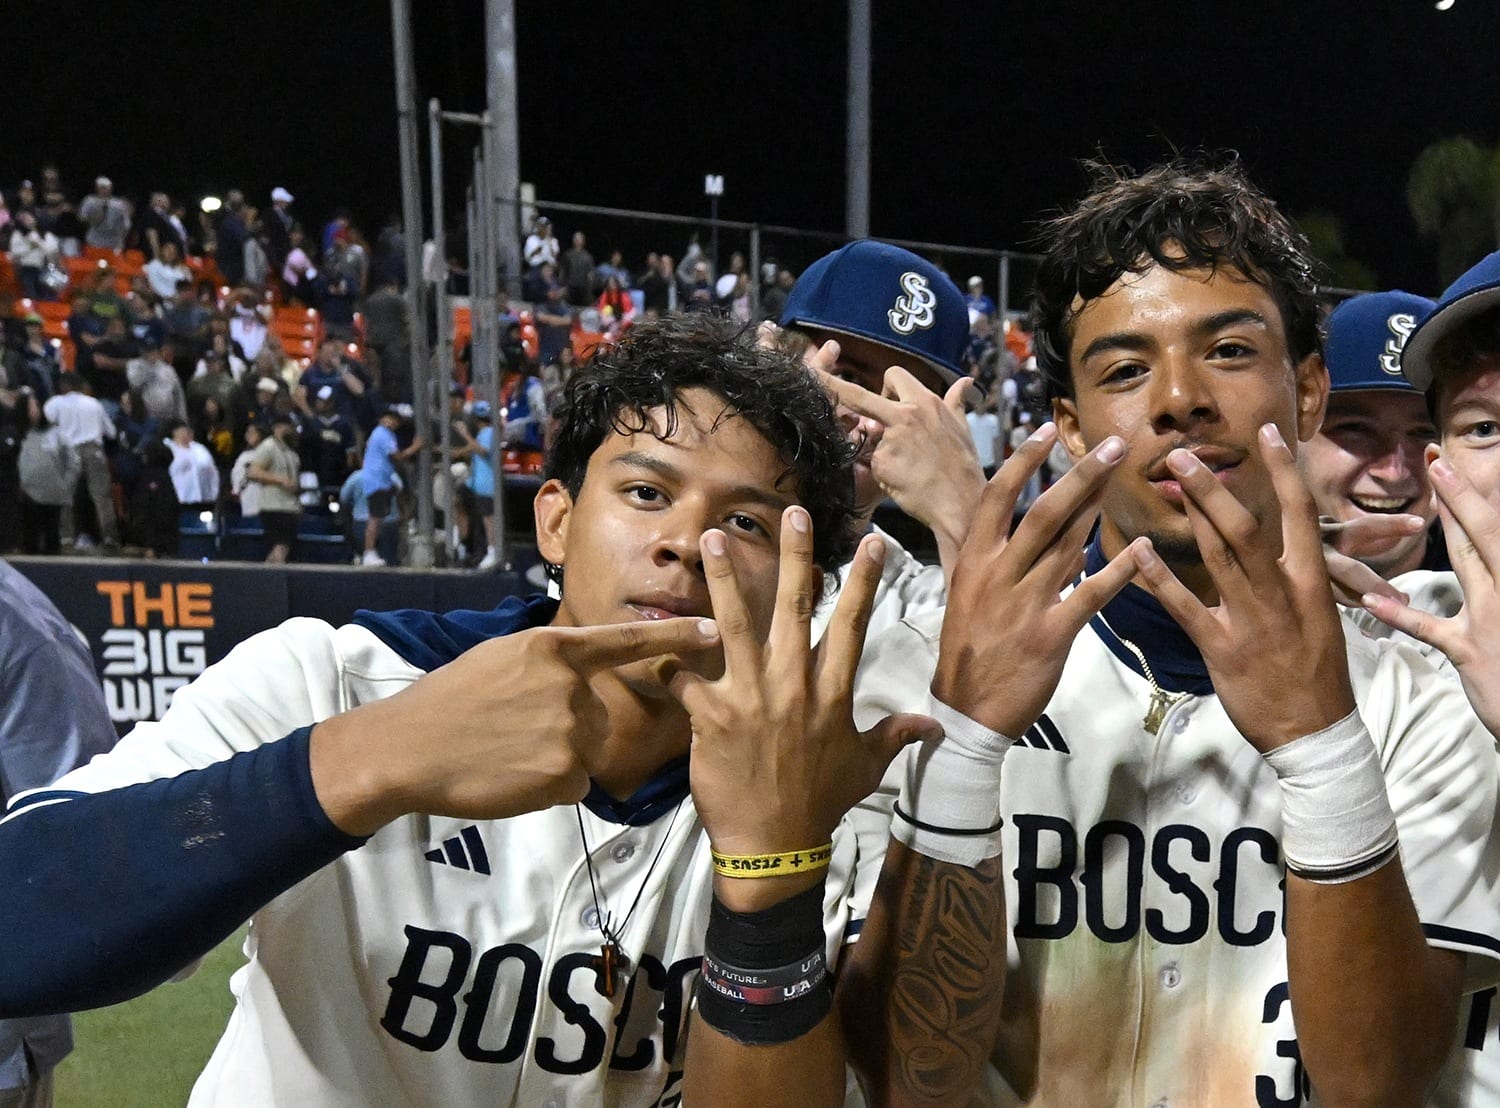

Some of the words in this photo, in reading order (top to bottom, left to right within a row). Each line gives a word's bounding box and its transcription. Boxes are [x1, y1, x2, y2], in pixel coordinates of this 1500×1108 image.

[96, 581, 215, 628] THE
[101, 629, 206, 675] BIG
[102, 676, 190, 722] WE
[731, 858, 782, 870] JESUS
[1012, 814, 1287, 947] BOSC
[722, 969, 760, 984] FUTURE
